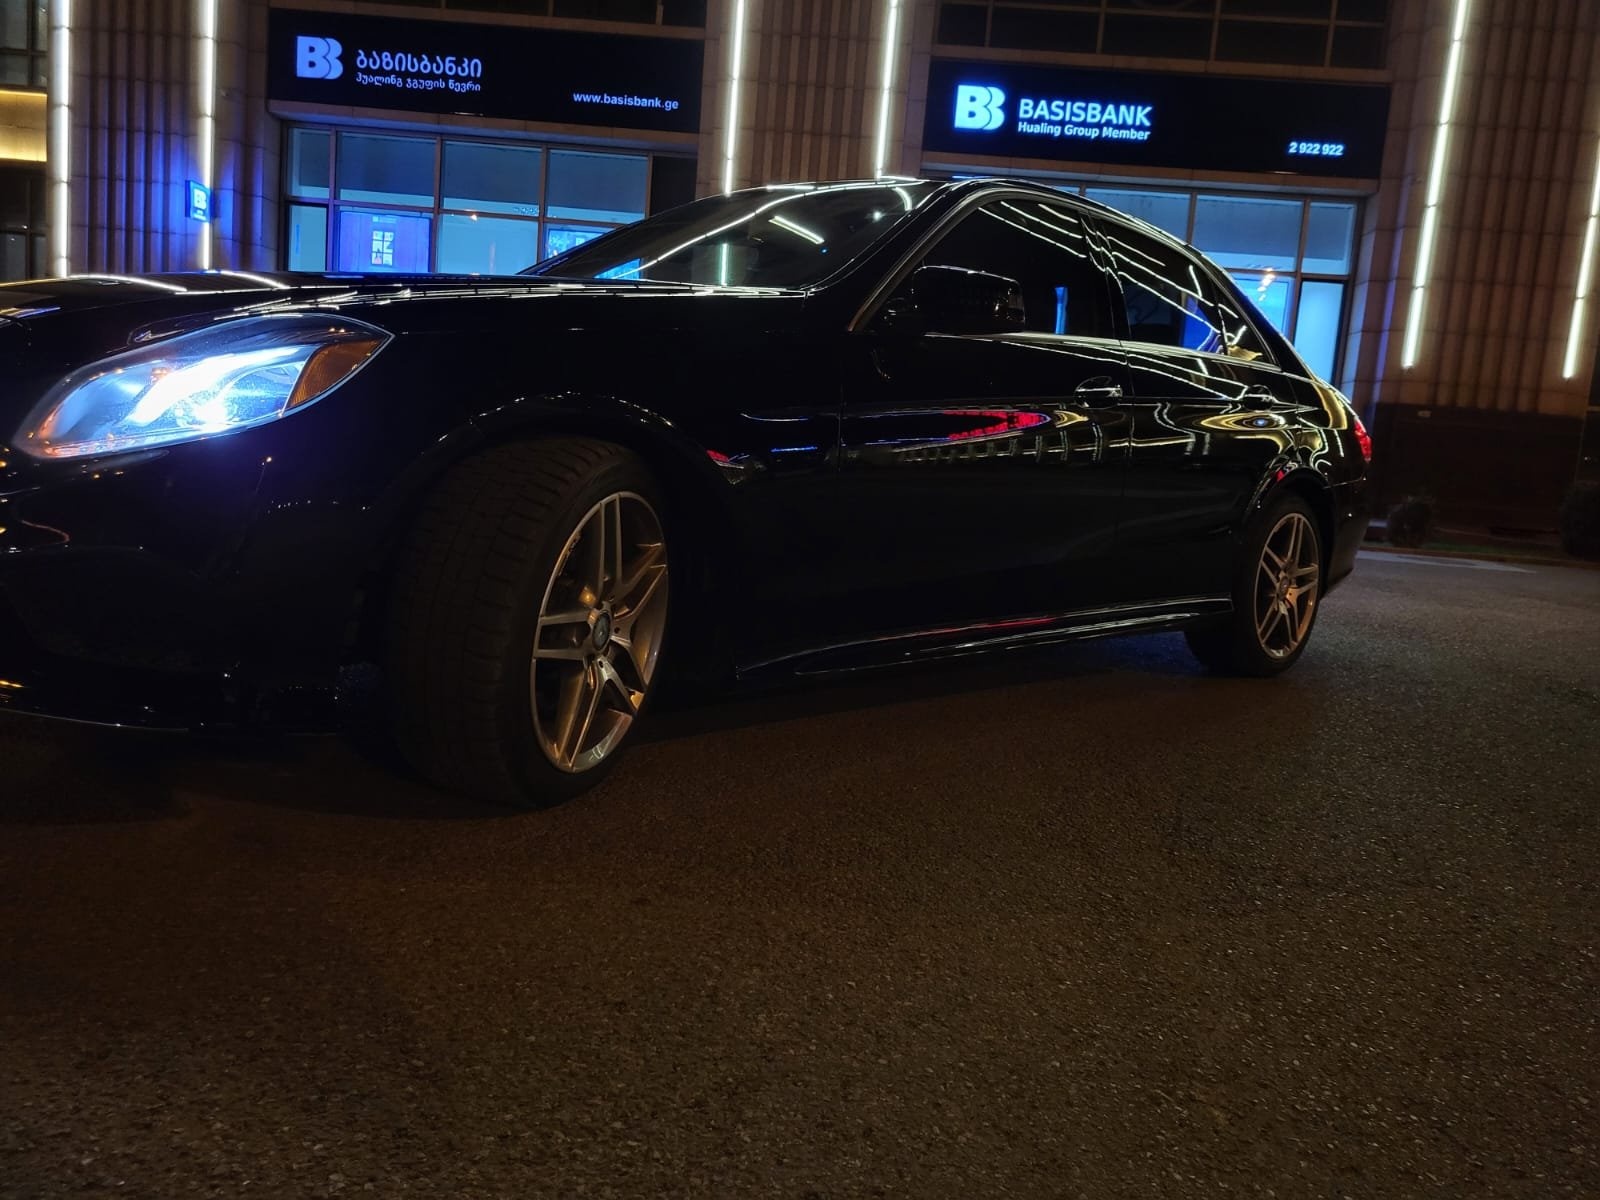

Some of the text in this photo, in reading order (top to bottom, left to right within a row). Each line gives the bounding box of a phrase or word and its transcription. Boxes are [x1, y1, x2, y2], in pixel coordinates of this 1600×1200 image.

[356, 50, 482, 78] ბაზისბანკი
[448, 79, 481, 93] წევრი
[573, 92, 679, 112] www.basisbank.ge
[1018, 98, 1153, 127] BASISBANK
[1017, 120, 1151, 141] Hualing Group Member
[1288, 141, 1345, 156] 2 922 922
